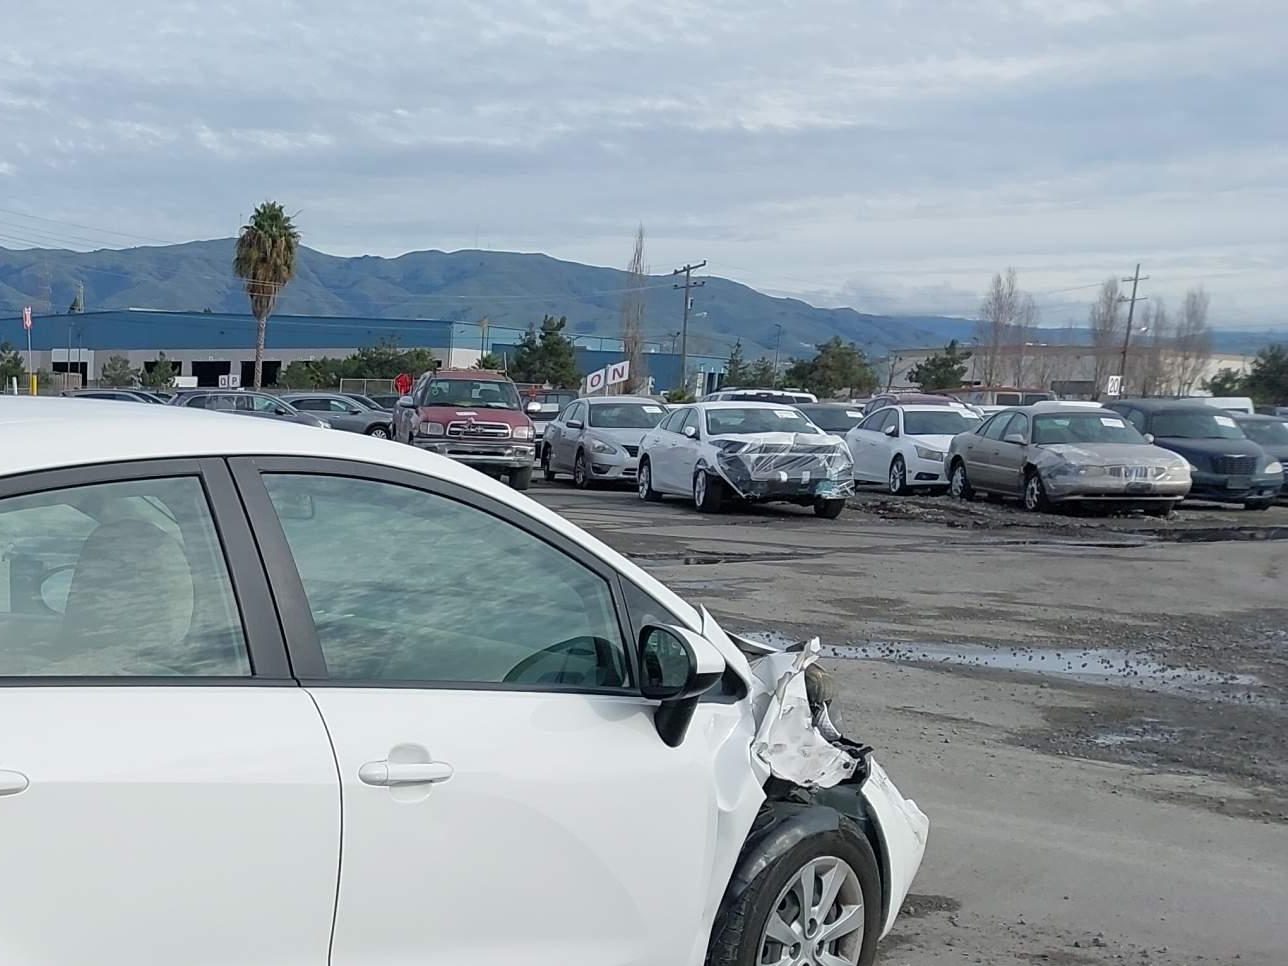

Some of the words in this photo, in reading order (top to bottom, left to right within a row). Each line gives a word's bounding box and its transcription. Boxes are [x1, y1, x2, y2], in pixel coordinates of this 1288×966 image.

[231, 376, 238, 386] P
[612, 365, 625, 381] N
[1109, 377, 1120, 393] 20
